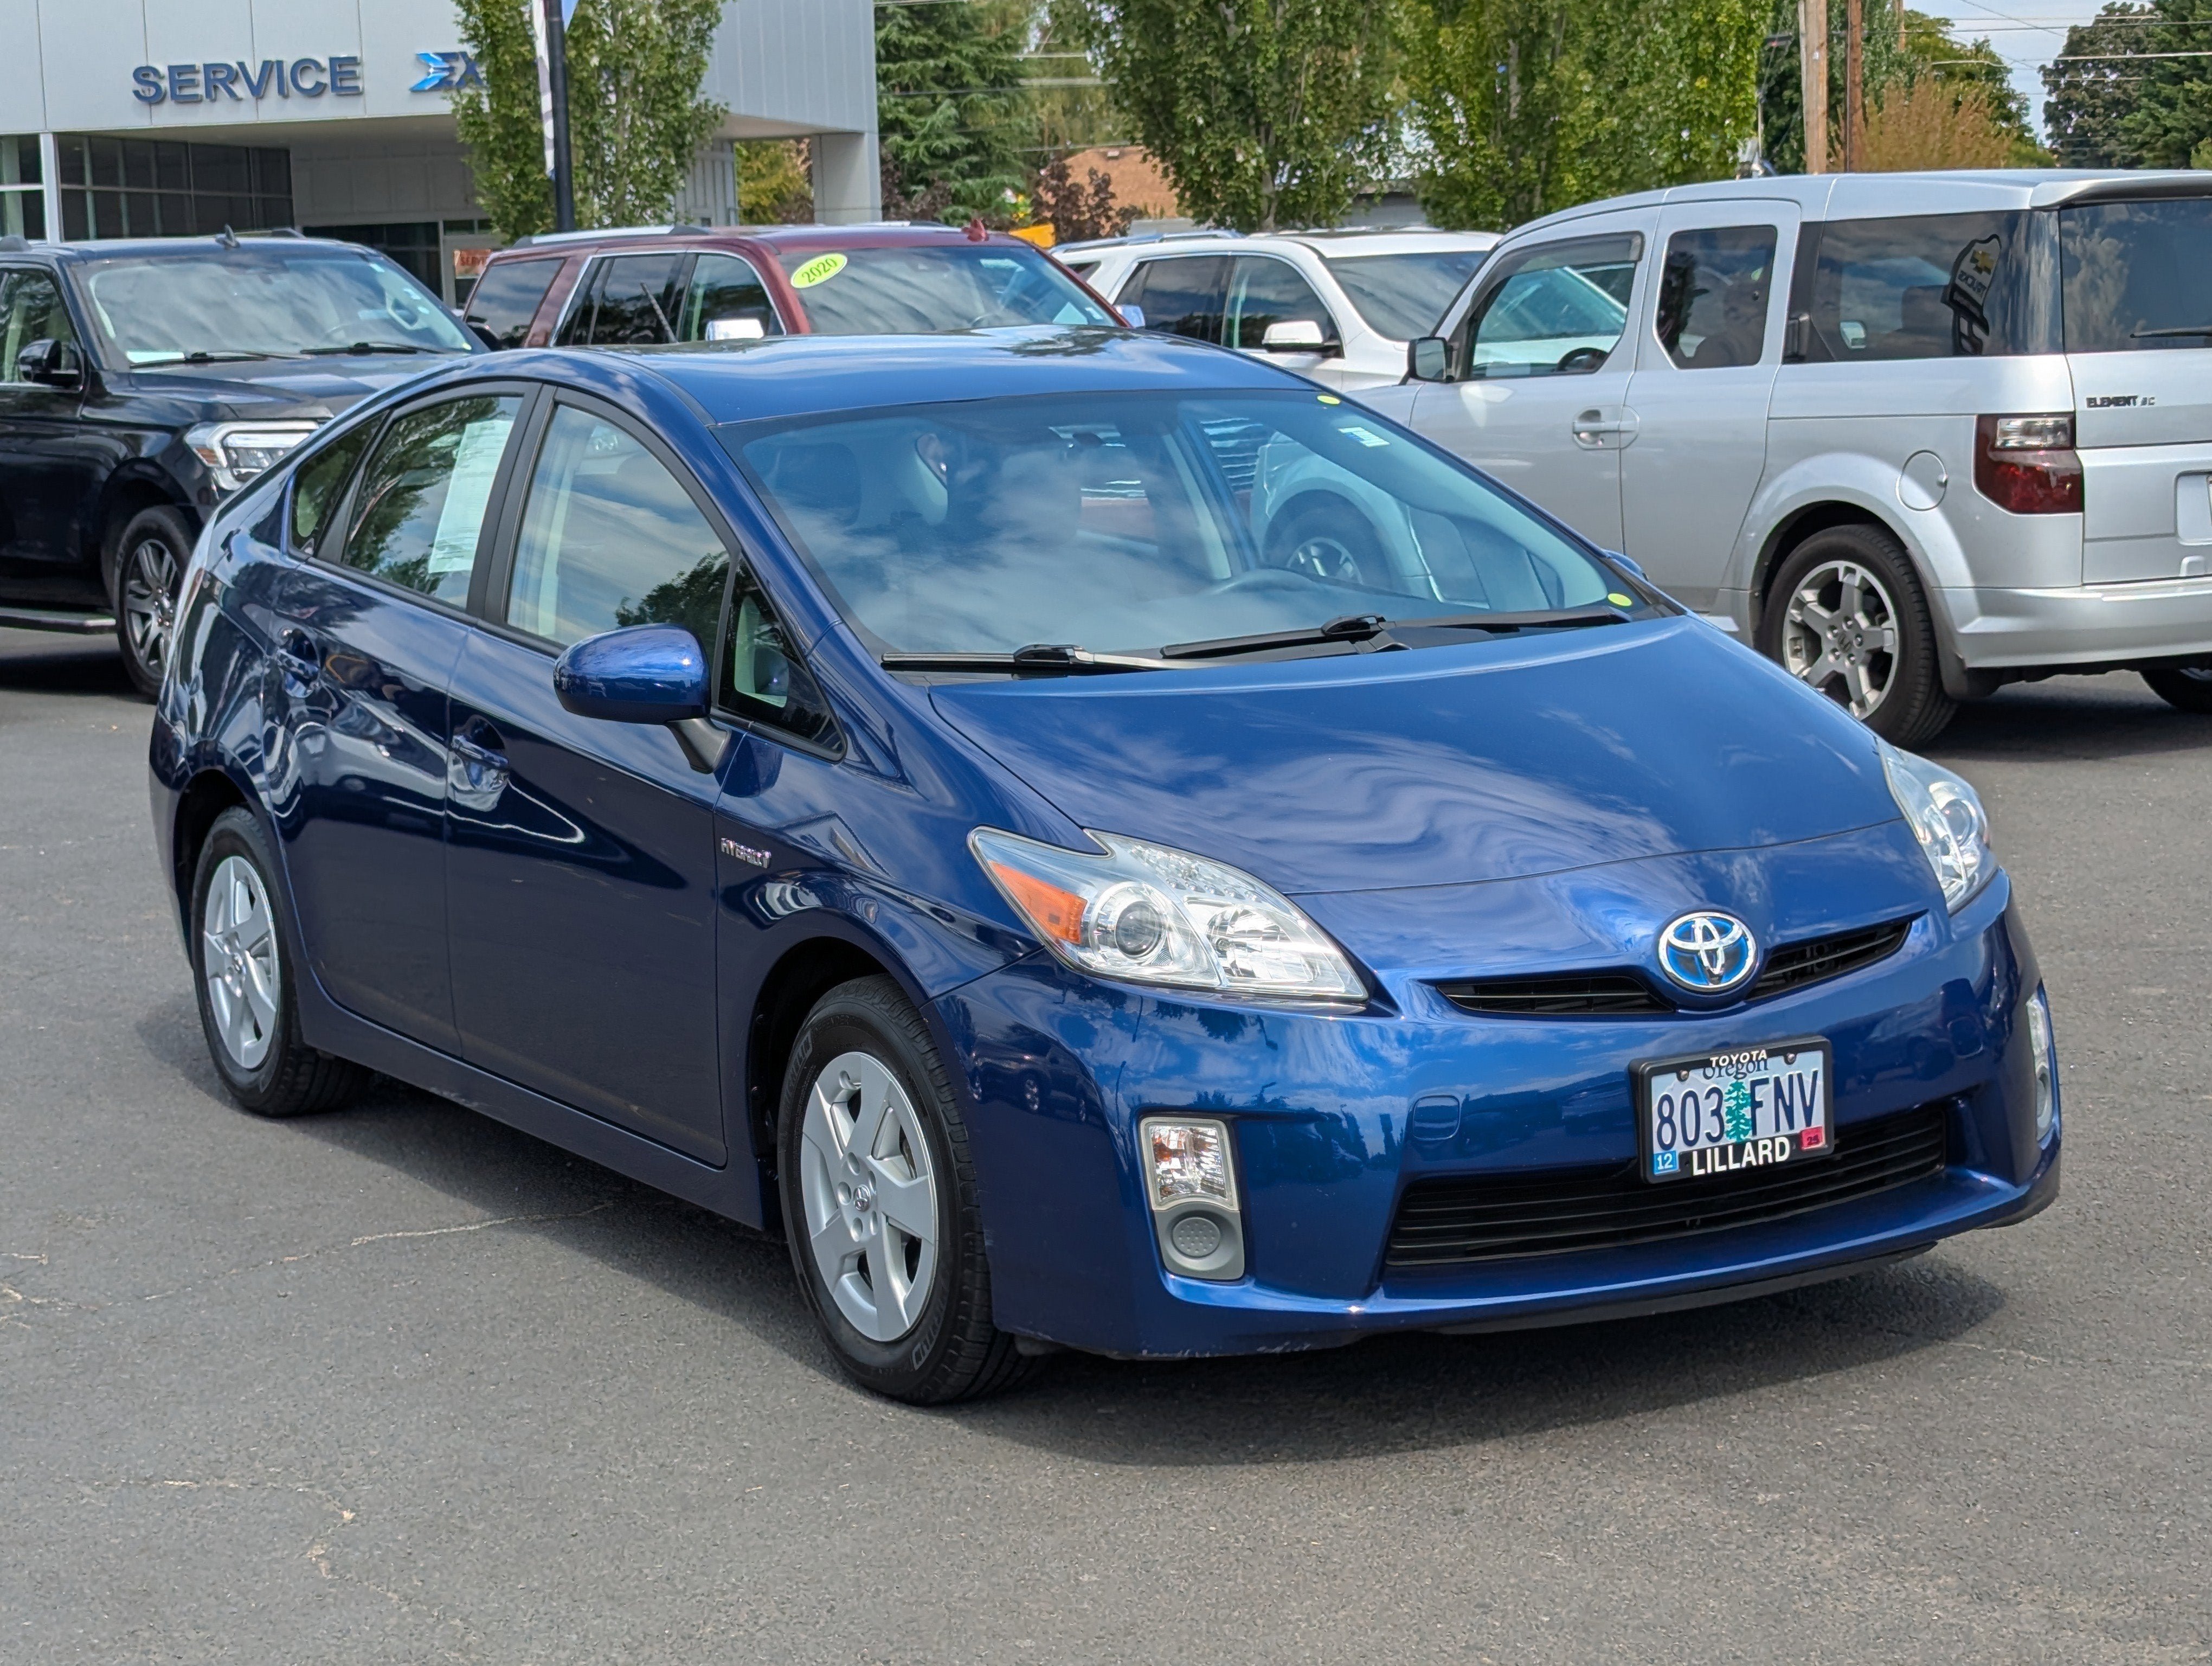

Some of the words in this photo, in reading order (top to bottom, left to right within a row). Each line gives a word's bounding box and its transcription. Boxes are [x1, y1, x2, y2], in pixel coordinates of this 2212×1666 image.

[132, 55, 364, 105] SERVICE
[801, 258, 837, 284] 2020
[2086, 395, 2138, 408] ELEMENT
[1702, 1058, 1769, 1080] Oregon
[1709, 1049, 1767, 1067] TOYOTA
[1657, 1086, 1725, 1151] 803
[1750, 1069, 1818, 1136] FNV
[1657, 1153, 1673, 1170] 12
[1692, 1136, 1790, 1176] LILLARD
